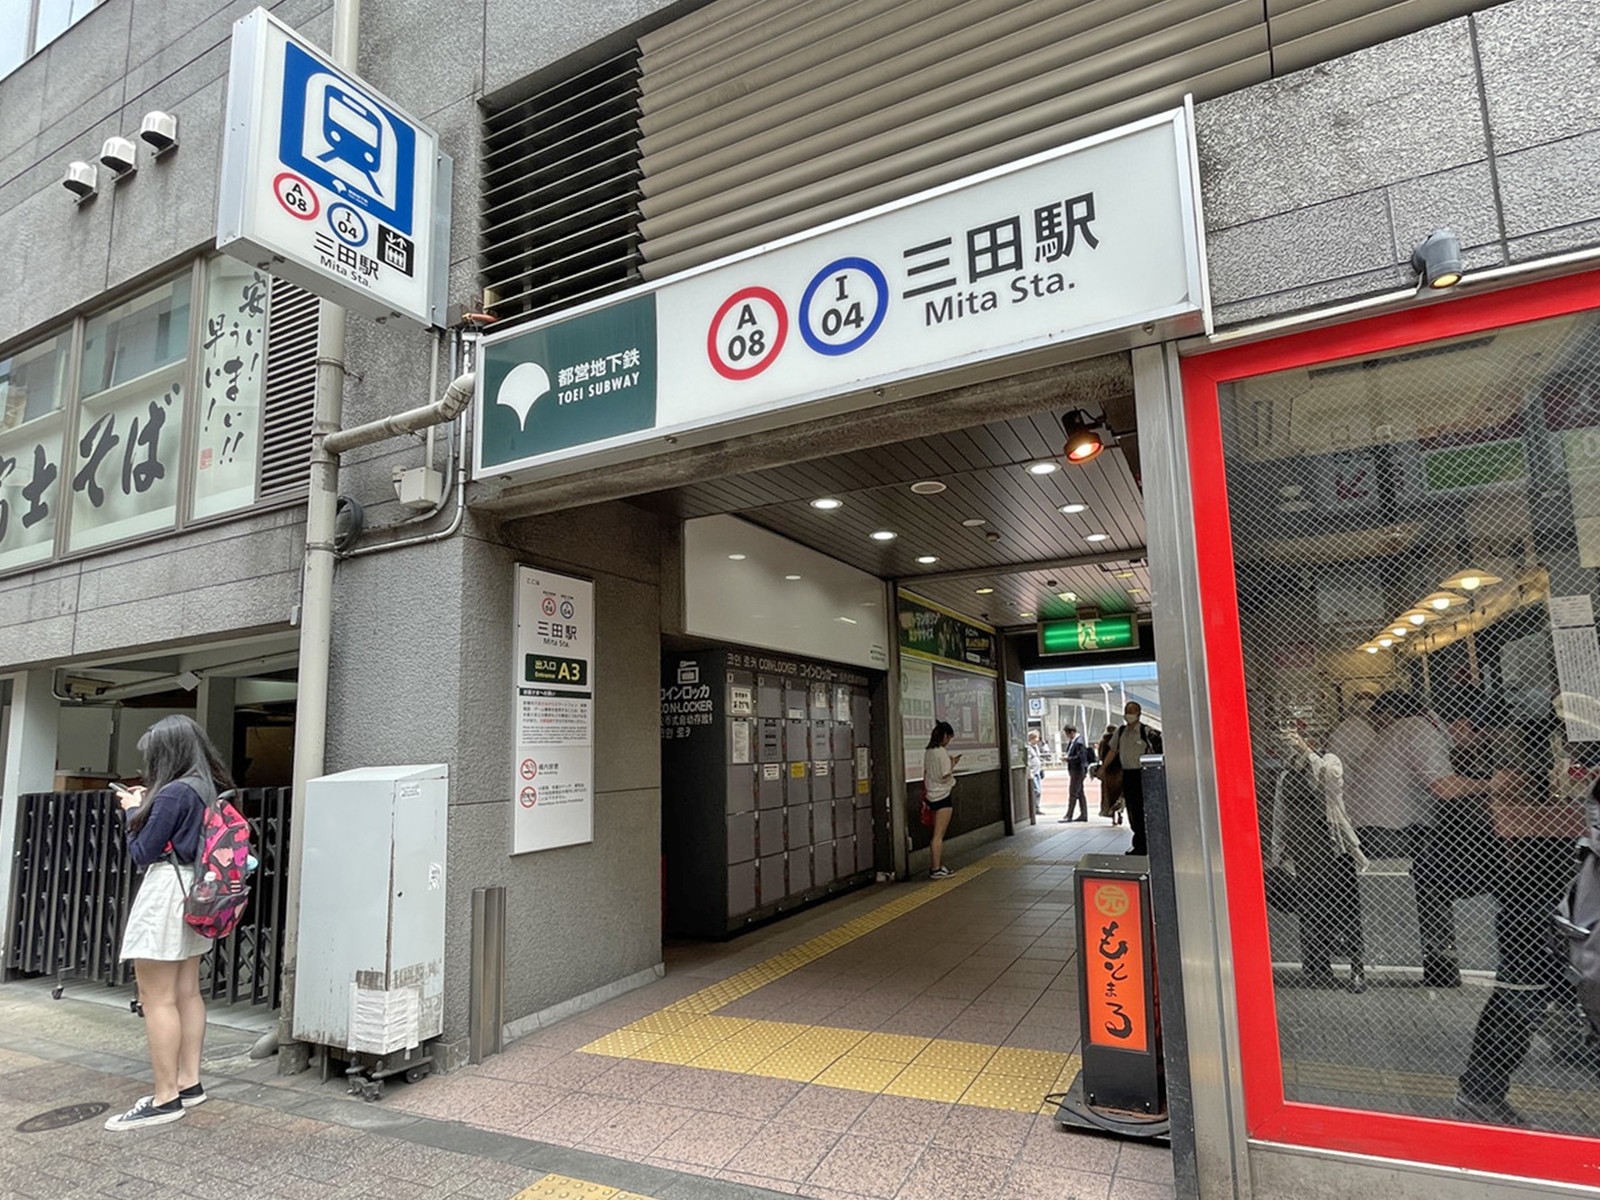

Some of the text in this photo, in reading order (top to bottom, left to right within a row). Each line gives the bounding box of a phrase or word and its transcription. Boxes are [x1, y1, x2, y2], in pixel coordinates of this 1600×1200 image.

[285, 192, 307, 212] 08
[292, 183, 303, 197] A
[338, 221, 358, 240] 04
[345, 211, 352, 224] I
[313, 231, 379, 281] 三田駅
[903, 191, 1100, 300] 三田駅
[320, 256, 372, 288] Mita Sta.
[835, 275, 849, 301] I
[925, 272, 1075, 326] Mita Sta.
[736, 304, 757, 331] A
[822, 302, 864, 336] 04
[728, 329, 765, 361] 08
[558, 348, 640, 387] 都営地下鉄
[558, 372, 640, 405] TOEI SUBWAY
[537, 620, 577, 640] 三田駅
[535, 659, 556, 671] 出入口
[558, 662, 581, 681] A3
